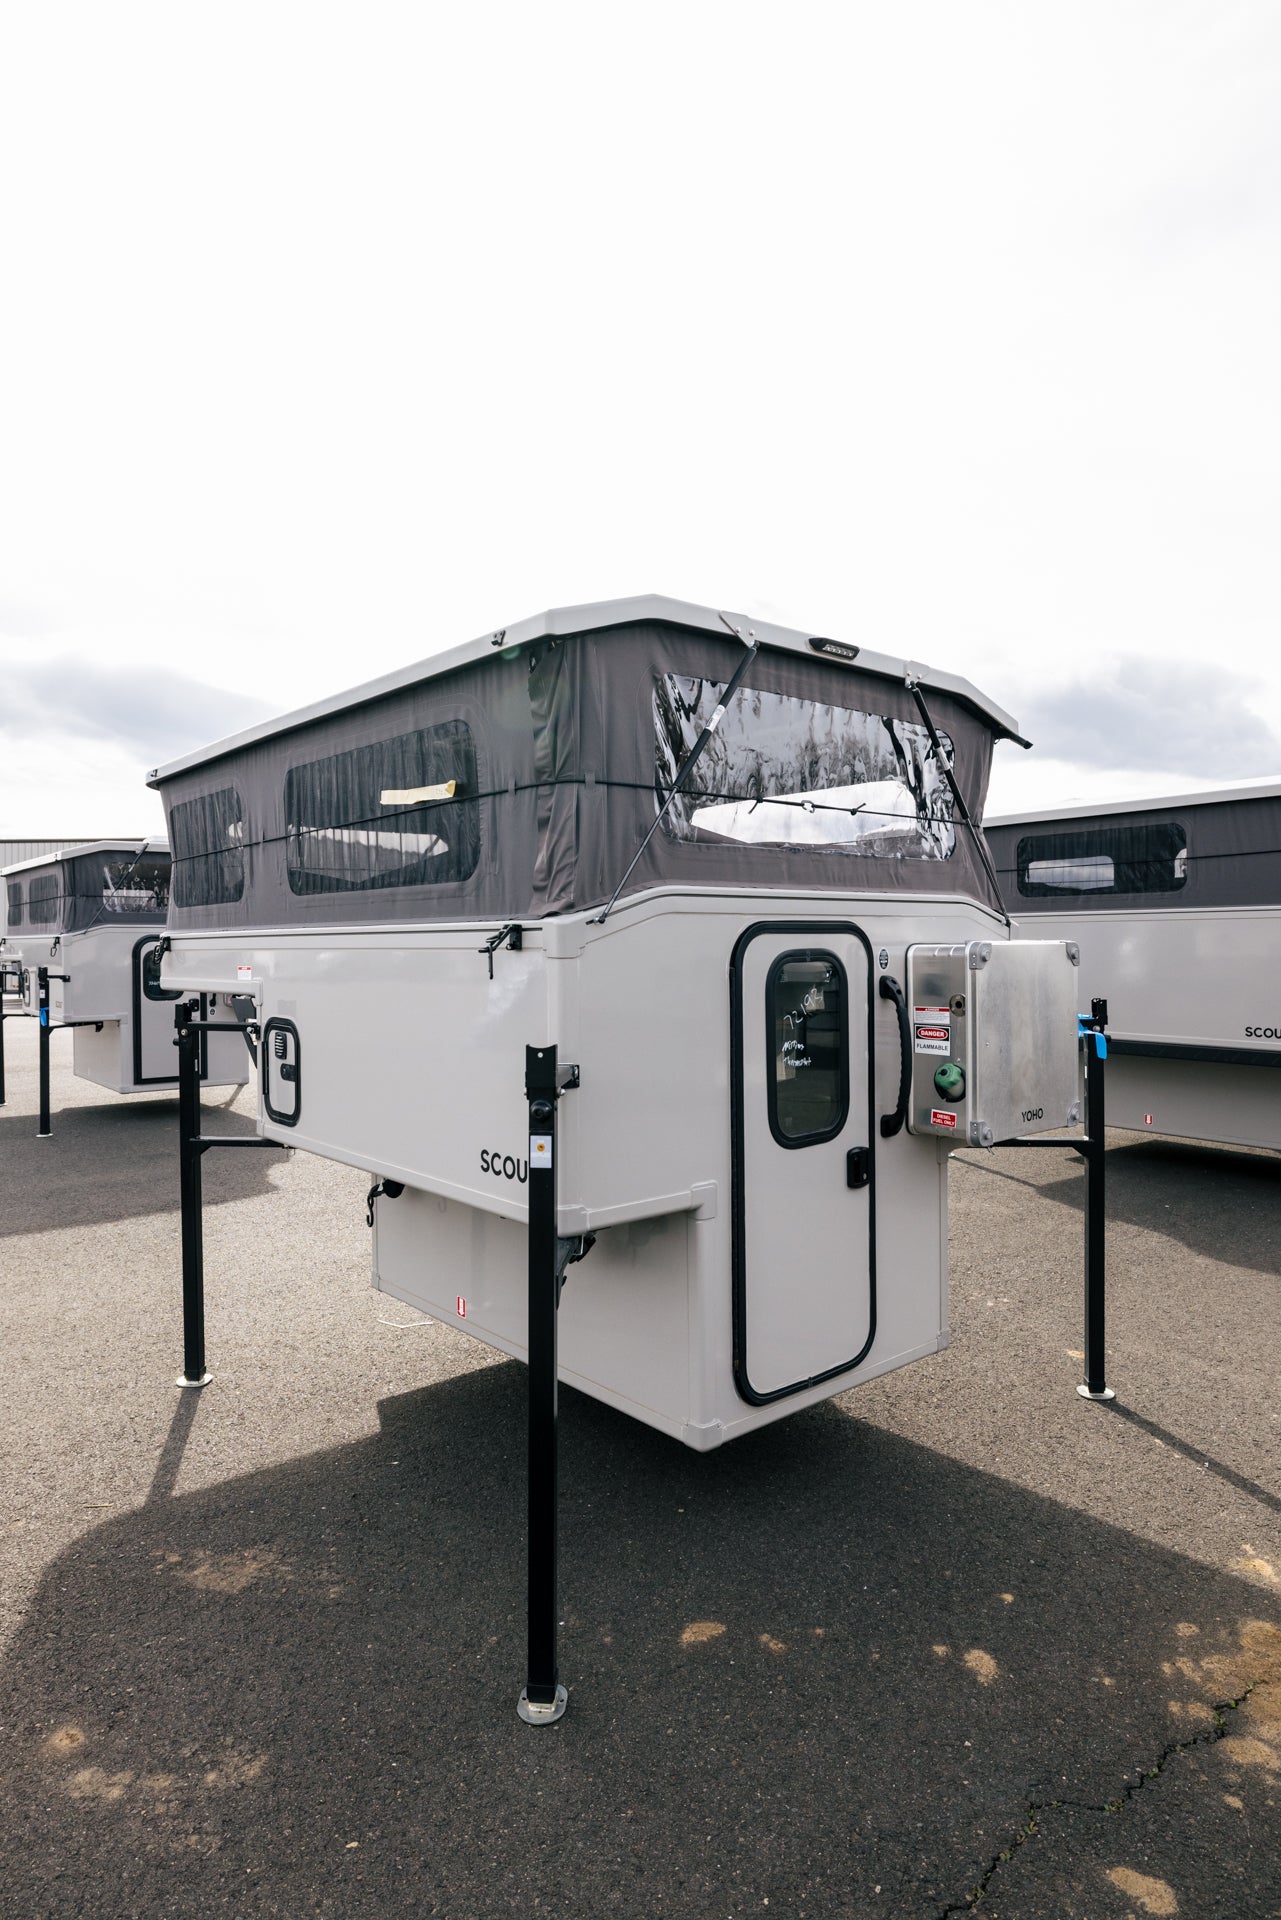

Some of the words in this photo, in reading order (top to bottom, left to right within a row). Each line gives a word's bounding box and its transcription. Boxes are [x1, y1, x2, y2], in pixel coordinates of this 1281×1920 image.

[920, 1030, 945, 1038] DANGER
[1245, 1026, 1281, 1039] SCOU
[916, 1043, 948, 1051] FLAMMABLE
[1021, 1107, 1043, 1123] YOHO
[480, 1149, 528, 1184] SCOU
